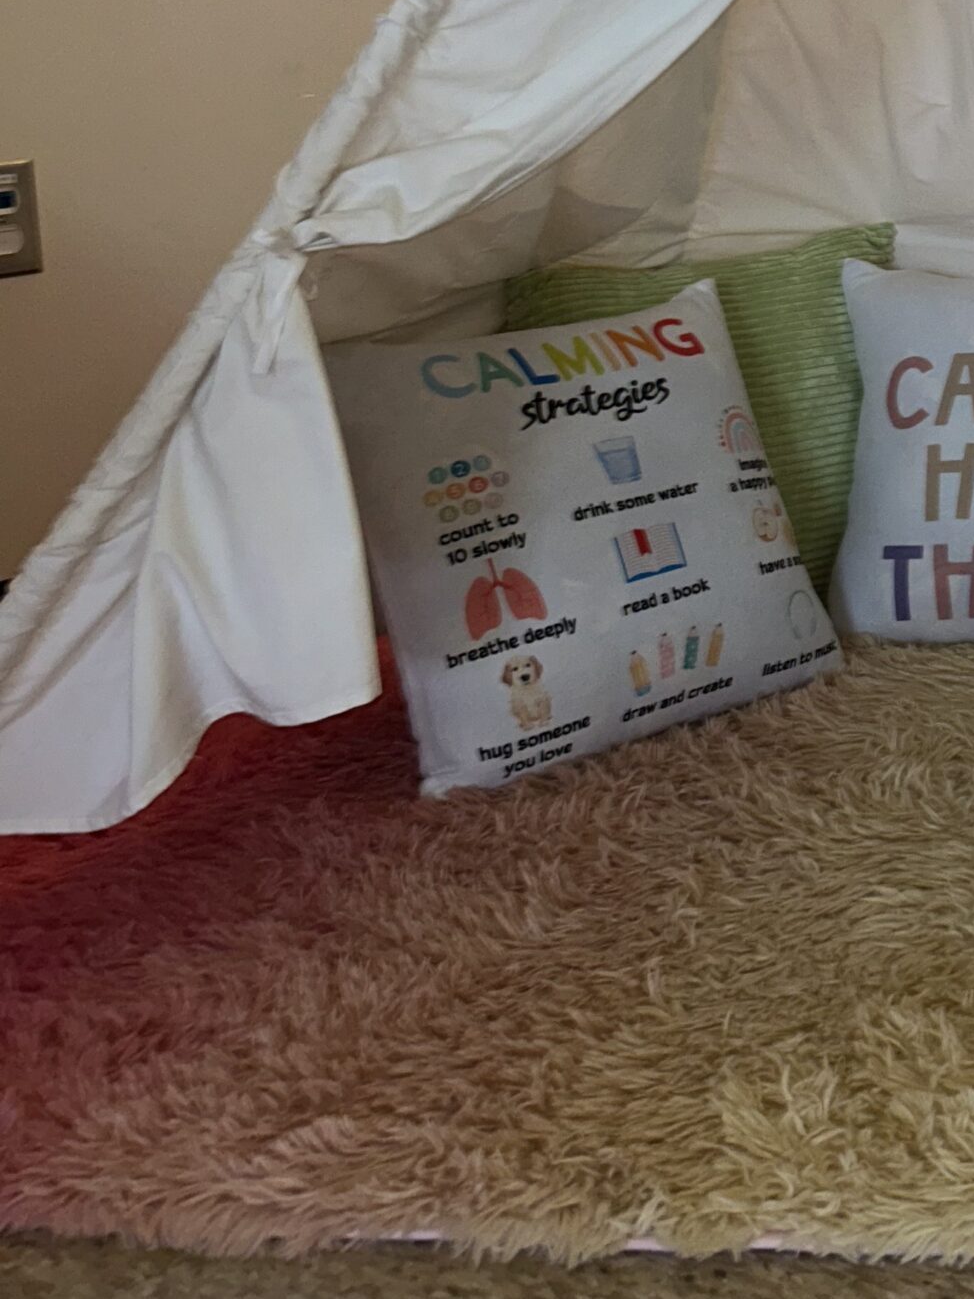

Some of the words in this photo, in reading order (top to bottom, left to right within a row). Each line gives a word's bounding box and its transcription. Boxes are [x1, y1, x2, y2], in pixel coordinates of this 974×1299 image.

[421, 318, 704, 398] CALMING
[520, 377, 670, 431] strategies
[573, 502, 614, 521] drink
[616, 493, 656, 512] some
[658, 482, 699, 501] water
[729, 482, 739, 493] a
[738, 476, 767, 491] happy
[439, 518, 494, 546] count
[497, 513, 519, 528] to
[447, 548, 468, 565] 10
[471, 531, 527, 559] slowly
[758, 558, 786, 575] have
[622, 593, 658, 616] read
[660, 592, 670, 603] a
[672, 578, 711, 601] book
[446, 638, 519, 669] breathe
[524, 616, 577, 644] deeply
[761, 654, 798, 677] listen
[800, 651, 813, 665] to
[622, 702, 656, 722] draw
[658, 689, 685, 710] and
[687, 676, 733, 699] create
[479, 742, 513, 762] hug
[517, 715, 591, 752] someone
[503, 756, 536, 779] you
[539, 742, 573, 763] love
